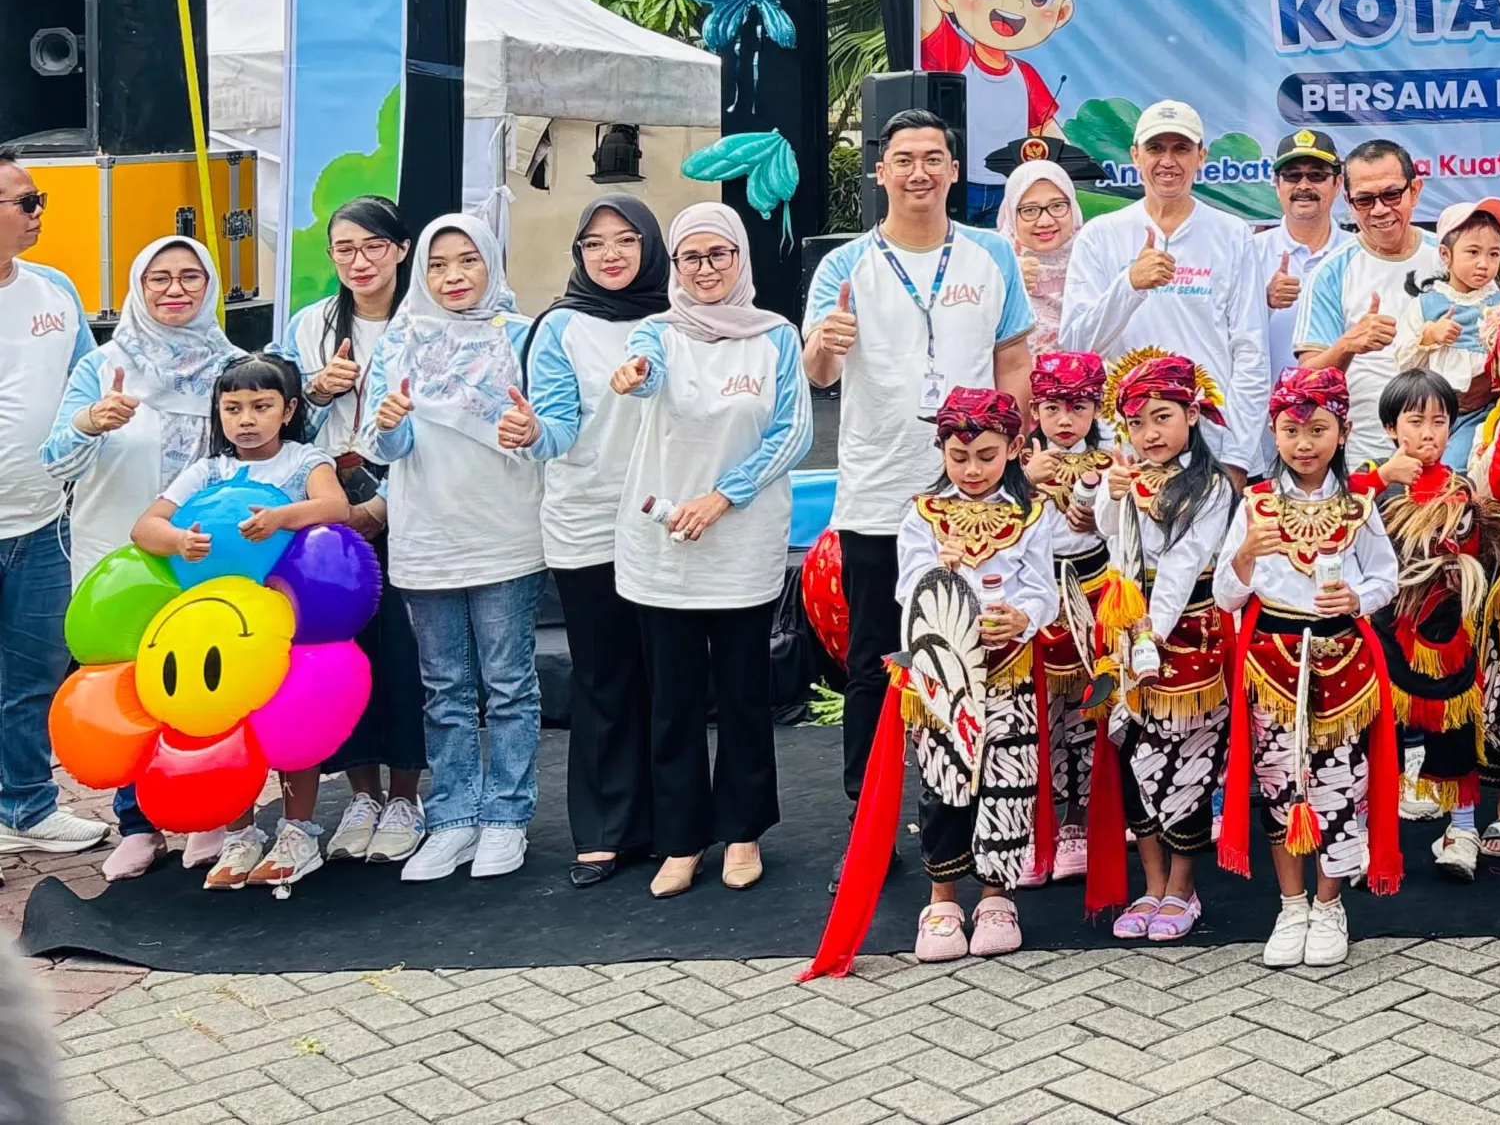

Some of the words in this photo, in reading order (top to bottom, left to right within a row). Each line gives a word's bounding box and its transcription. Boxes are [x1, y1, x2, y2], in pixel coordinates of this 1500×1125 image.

[1302, 81, 1489, 113] BERSAMA
[1175, 267, 1212, 277] DIKAN
[1171, 276, 1194, 285] UTU
[1177, 286, 1213, 295] SEMUA
